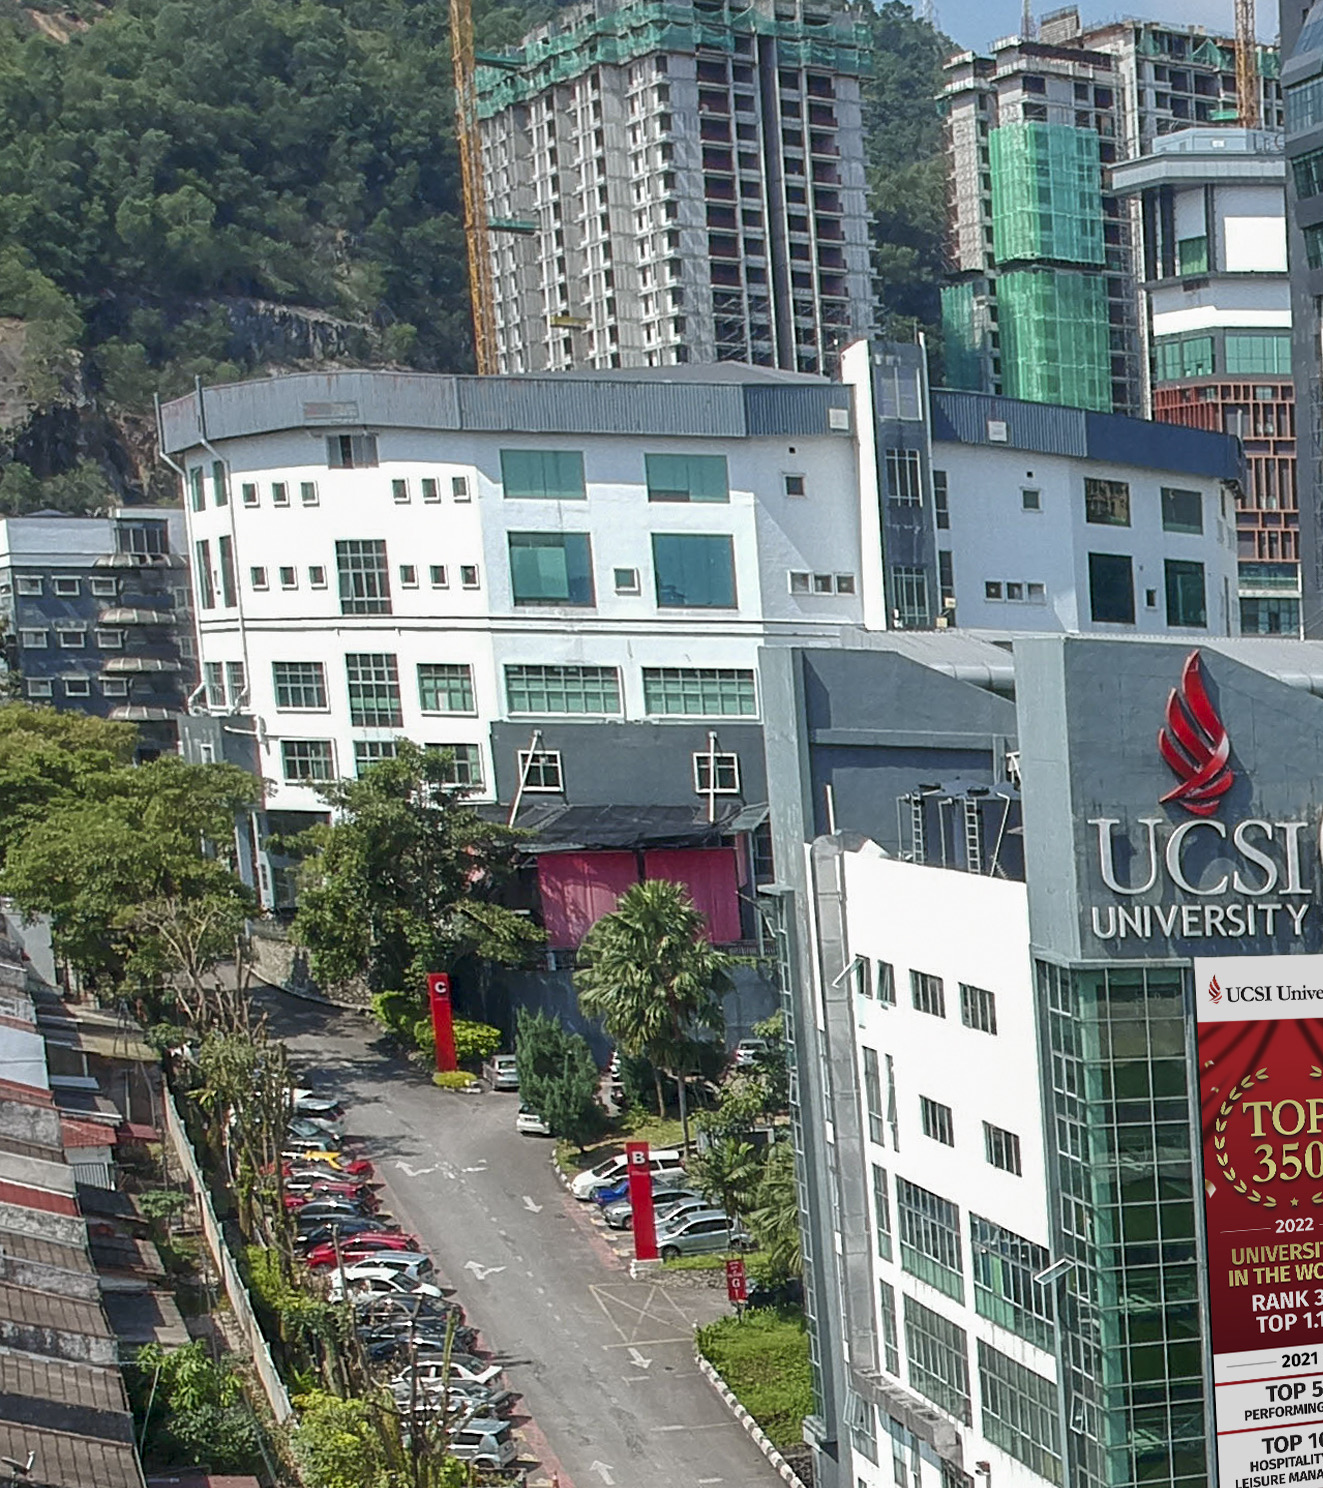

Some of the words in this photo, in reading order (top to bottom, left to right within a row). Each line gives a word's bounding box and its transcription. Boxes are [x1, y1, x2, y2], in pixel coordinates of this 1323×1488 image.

[1088, 818, 1313, 896] UCSI
[1091, 903, 1310, 939] UNIVERSITY
[434, 981, 447, 994] C
[1226, 986, 1273, 1003] UCSI
[631, 1151, 646, 1165] B
[1275, 1217, 1315, 1234] 2022
[1228, 1269, 1249, 1287] IN
[1253, 1266, 1291, 1285] THE
[1252, 1290, 1310, 1312] RANK
[1256, 1314, 1298, 1334] TOP
[1281, 1351, 1318, 1368] 2021
[1265, 1382, 1306, 1402] TOP
[1262, 1434, 1303, 1455] TOP
